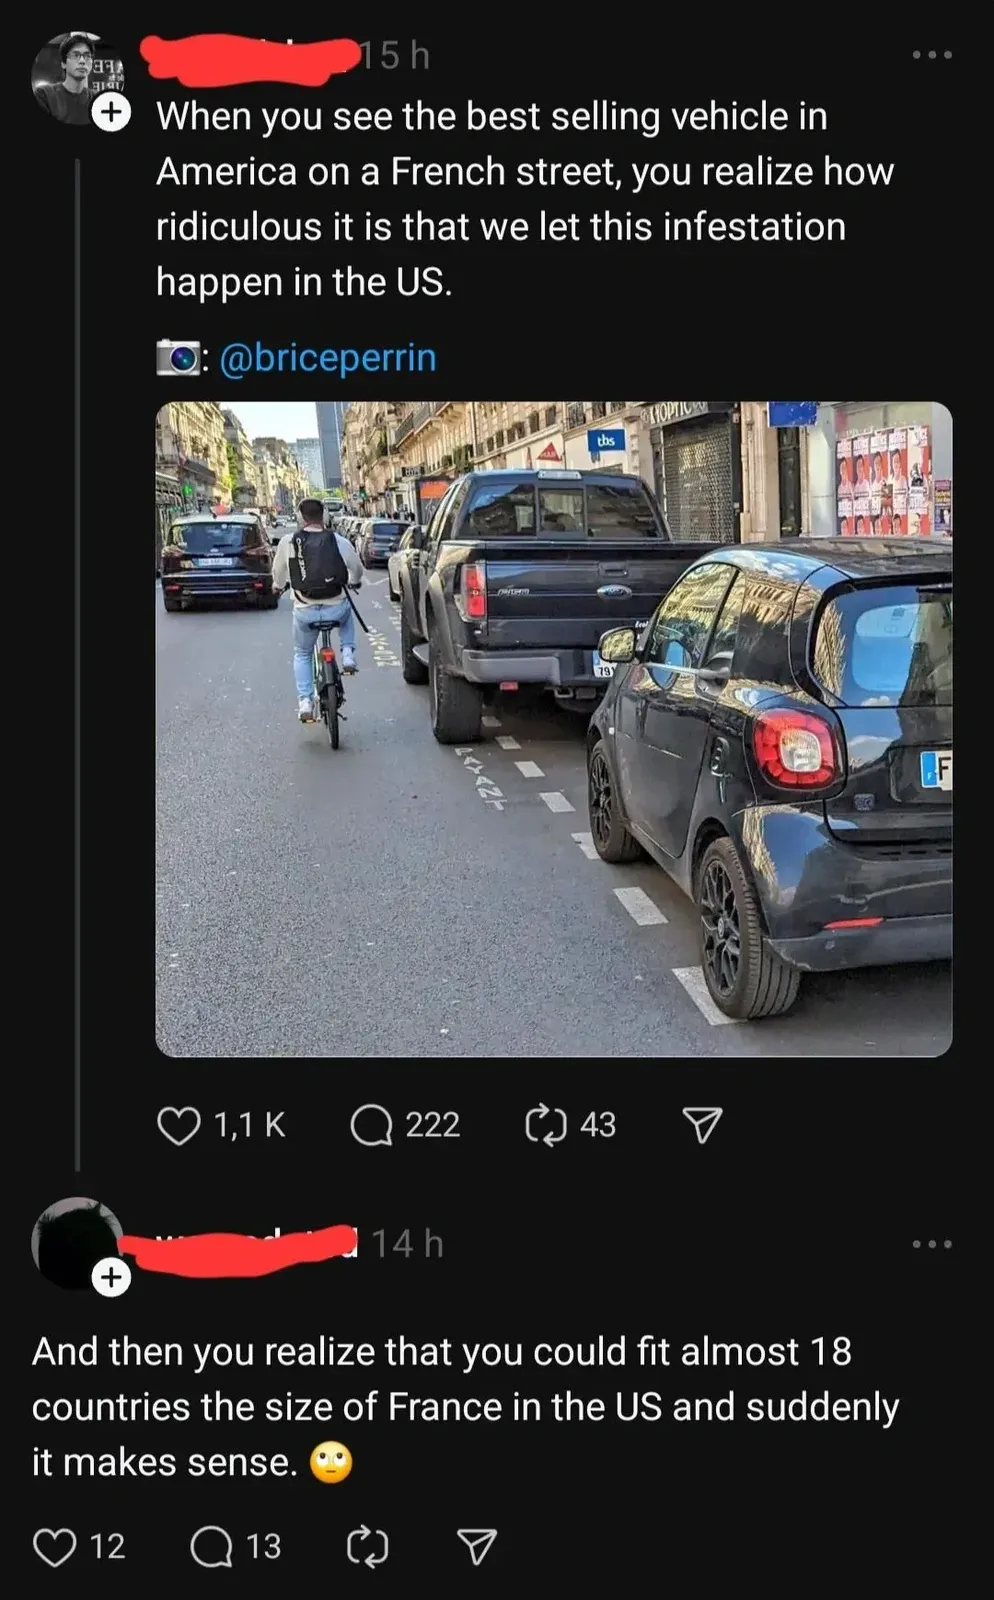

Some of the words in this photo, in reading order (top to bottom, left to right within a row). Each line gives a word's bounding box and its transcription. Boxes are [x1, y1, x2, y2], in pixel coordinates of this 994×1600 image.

[597, 433, 616, 447] tbs
[454, 747, 508, 811] PAYANT
[938, 756, 952, 781] F
